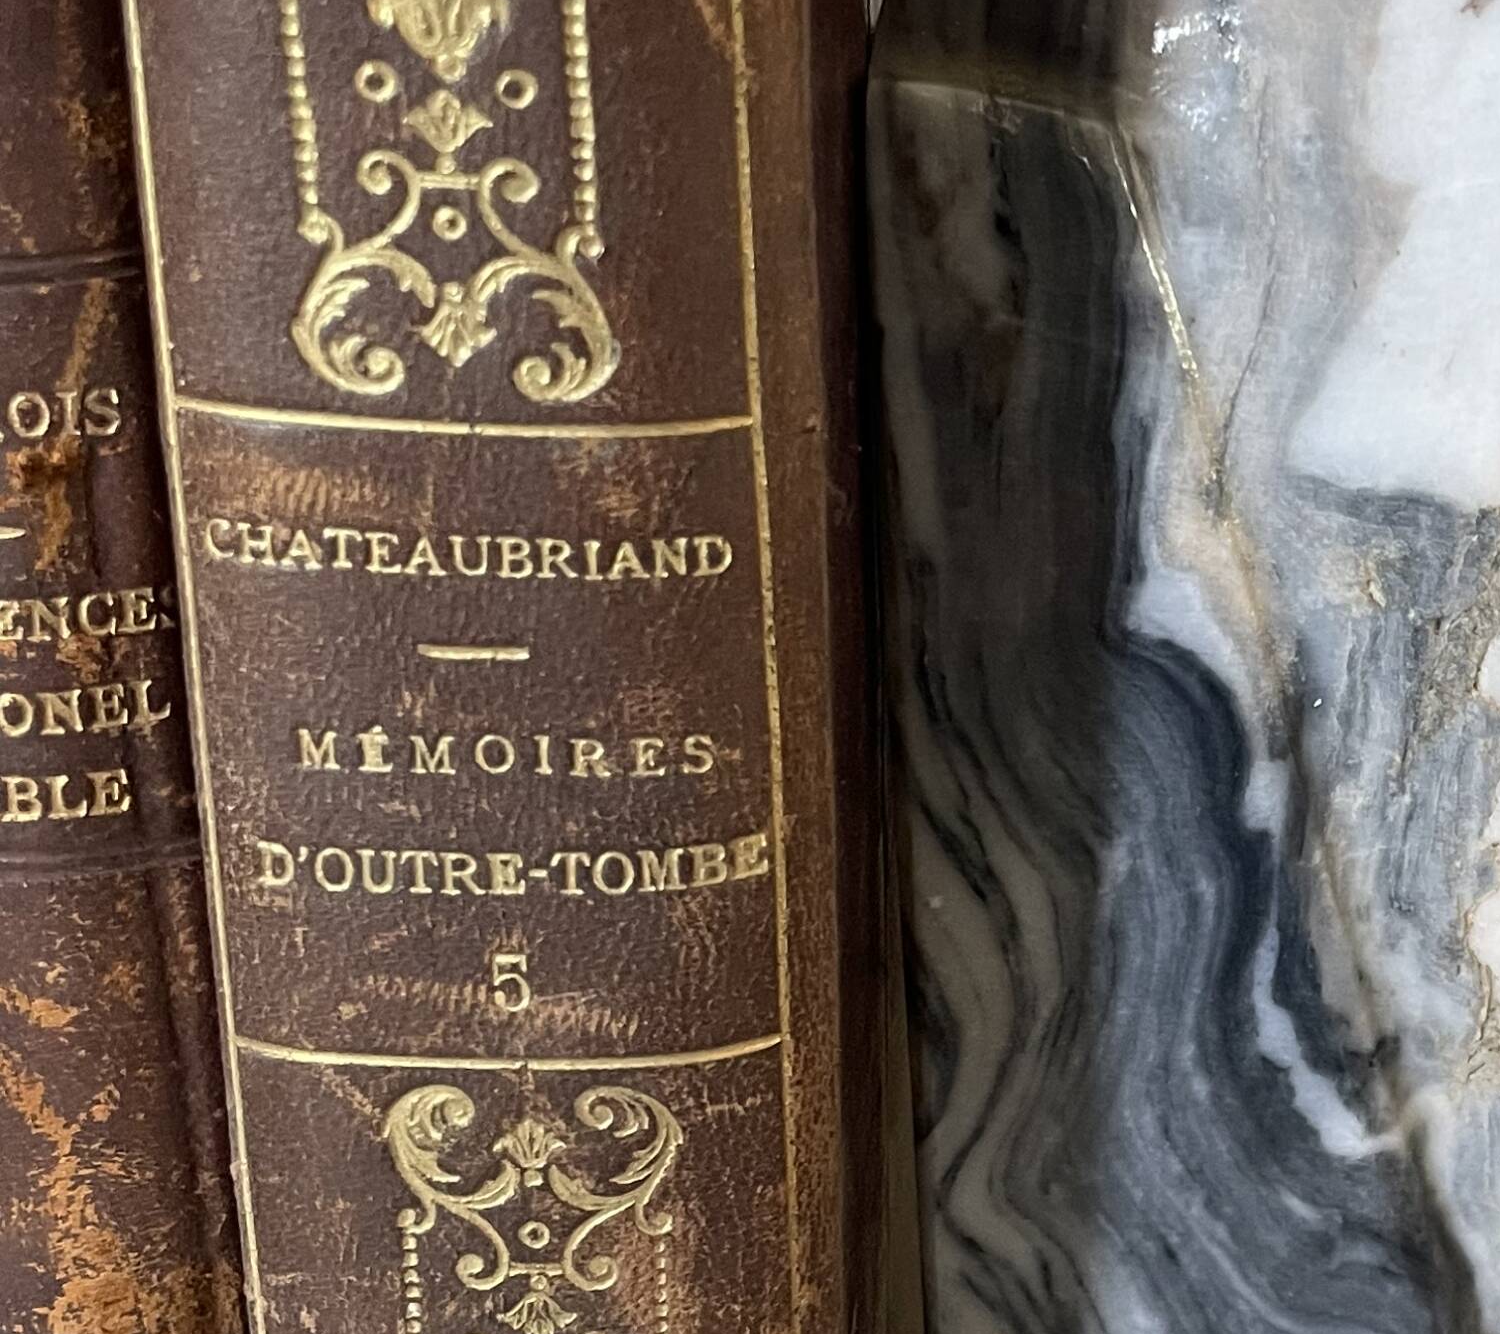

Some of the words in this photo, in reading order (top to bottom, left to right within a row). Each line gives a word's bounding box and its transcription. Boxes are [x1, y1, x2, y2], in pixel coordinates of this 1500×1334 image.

[0, 388, 121, 443] OIS
[205, 518, 733, 580] CHATEAUBRIAND
[298, 724, 715, 778] MÉMOIRES
[257, 833, 770, 896] D'OUTRE-TOMBE
[490, 953, 532, 1013] 5
